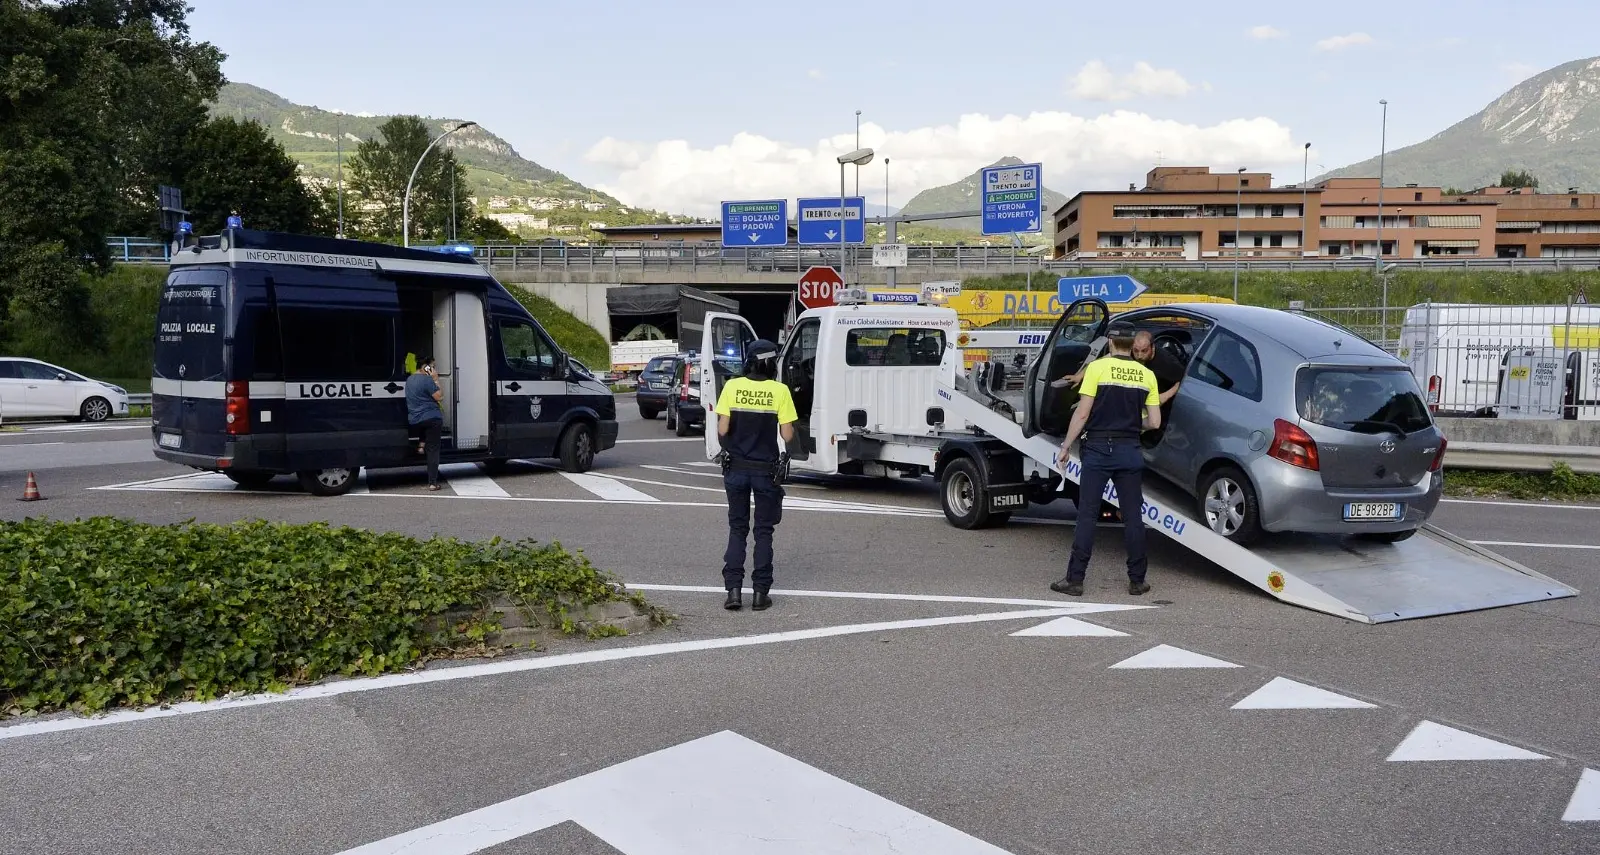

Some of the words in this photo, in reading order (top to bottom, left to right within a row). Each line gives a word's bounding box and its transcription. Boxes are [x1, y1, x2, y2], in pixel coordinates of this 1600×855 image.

[997, 203, 1026, 211] VERONA
[742, 214, 780, 222] BOLZANO
[805, 210, 832, 218] TRENTO
[997, 211, 1034, 219] ROVERETO
[246, 251, 327, 264] INFORTUNISTICA
[328, 256, 374, 267] STRADALE
[1072, 283, 1109, 297] VELA
[1117, 284, 1123, 294] 1
[878, 294, 914, 302] TRAPASSO
[1003, 293, 1044, 315] DAL
[837, 318, 856, 326] Allianz
[857, 318, 876, 326] Global
[875, 318, 904, 326] Assistance
[161, 323, 181, 333] POLIZIA
[186, 323, 216, 334] LOCALE
[1110, 366, 1144, 377] POLIZIA
[1111, 373, 1144, 383] LOCALE
[300, 384, 373, 398] LOCALE
[736, 389, 773, 398] POLIZIA
[735, 397, 773, 406] LOCALE
[993, 494, 1024, 507] ISOLI
[1350, 503, 1362, 516] DE
[1365, 503, 1395, 516] 982BP
